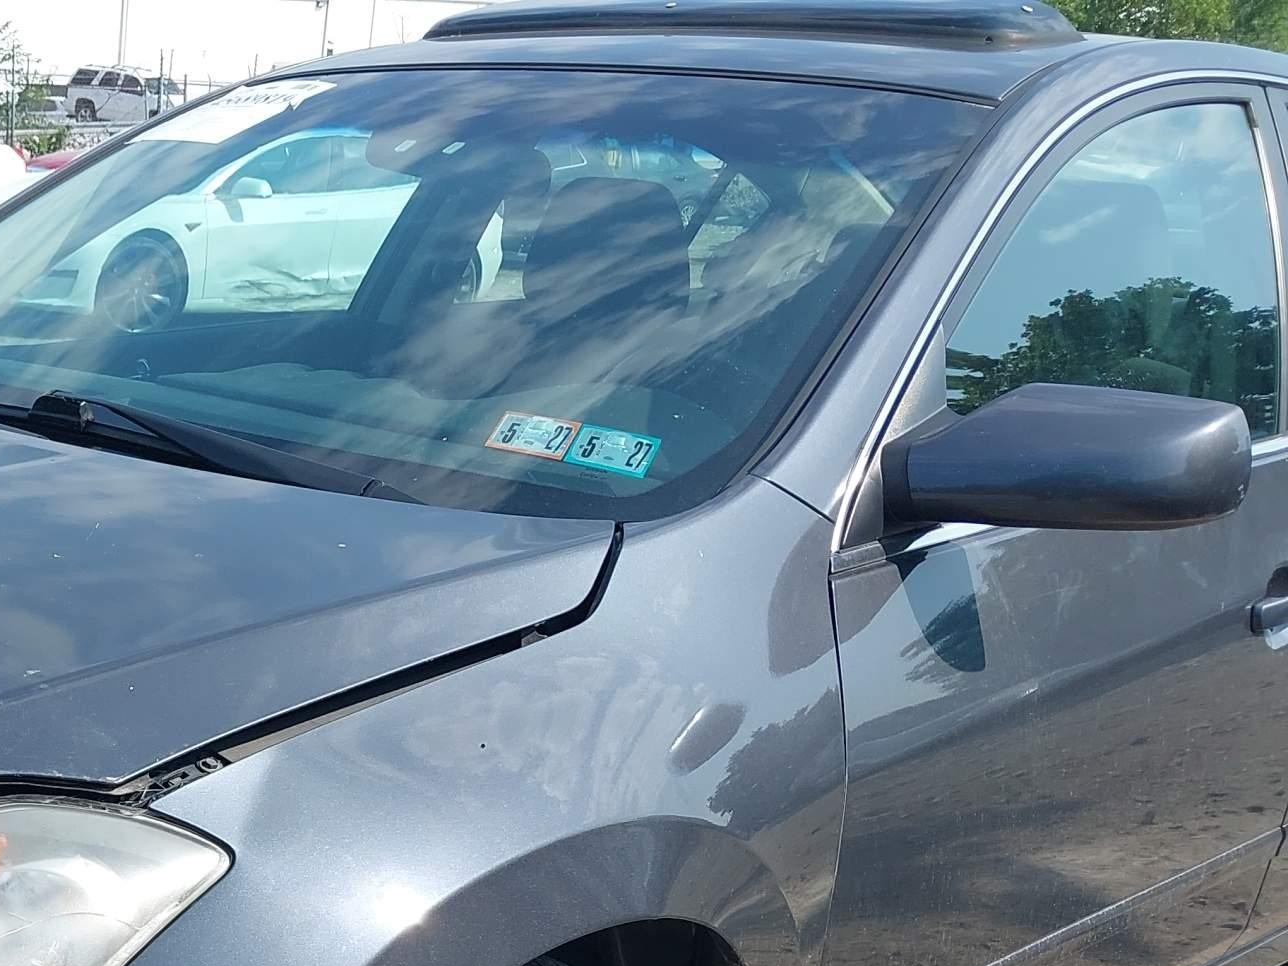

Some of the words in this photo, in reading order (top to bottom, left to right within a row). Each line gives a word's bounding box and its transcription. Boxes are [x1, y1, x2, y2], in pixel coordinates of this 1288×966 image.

[501, 422, 521, 444] 5
[544, 425, 573, 454] 27
[580, 436, 601, 458] 5
[625, 441, 653, 470] 27
